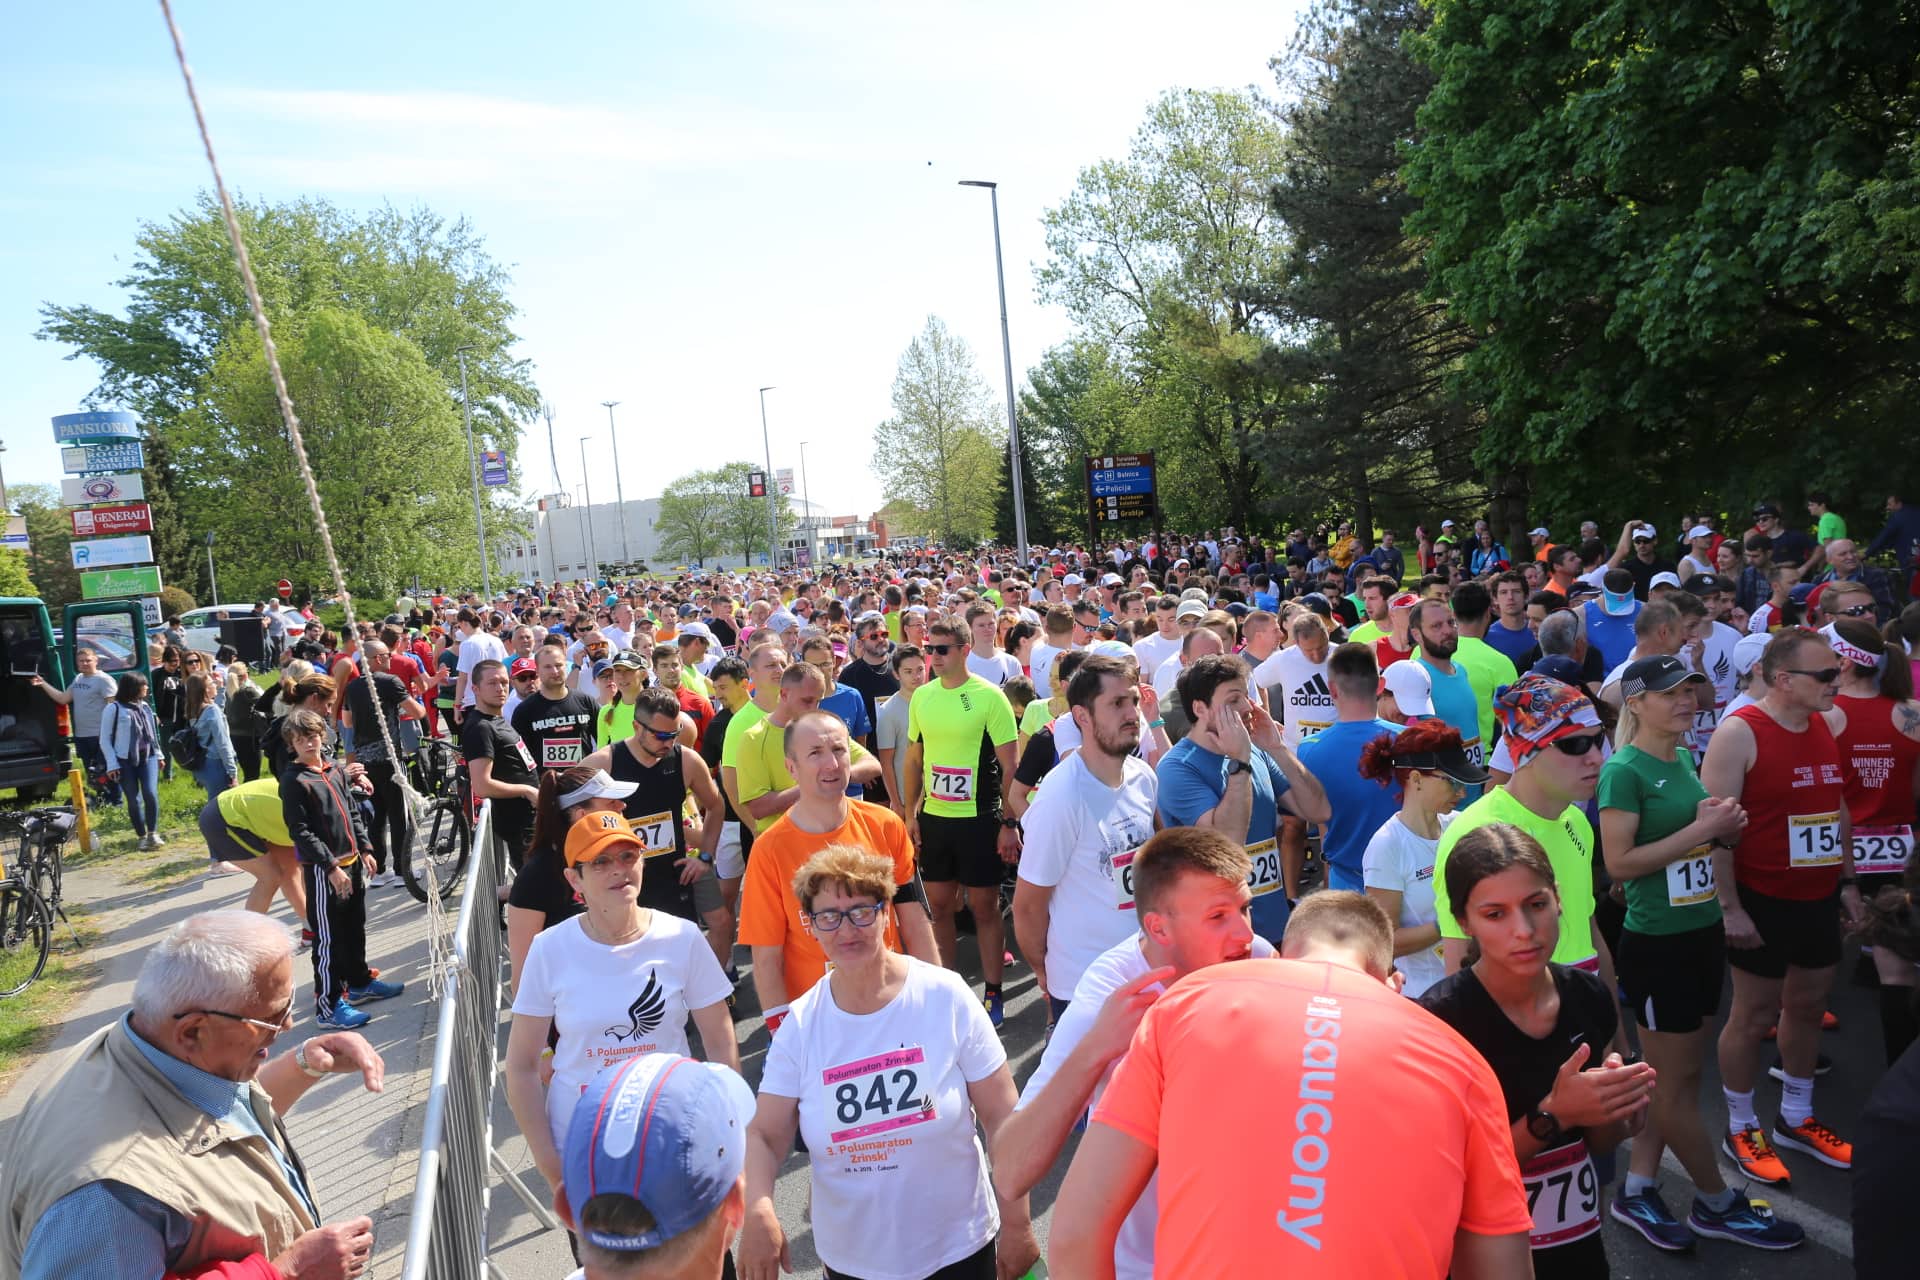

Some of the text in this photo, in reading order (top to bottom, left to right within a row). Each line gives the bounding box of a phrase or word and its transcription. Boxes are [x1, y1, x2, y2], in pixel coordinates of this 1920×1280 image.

[87, 442, 136, 452] SOBE
[88, 450, 138, 459] ROOMS
[88, 456, 138, 465] CAMERE
[88, 462, 140, 470] ZIMMER
[1105, 484, 1132, 493] Policija
[94, 510, 146, 522] GENERALI
[1120, 510, 1144, 518] Groblje
[144, 614, 159, 622] ON
[532, 715, 576, 731] MUSCLE
[577, 714, 591, 725] UP
[1695, 708, 1725, 728] 71
[547, 746, 578, 761] 887
[1851, 757, 1895, 768] WINNERS
[1858, 767, 1889, 778] NEVER
[931, 773, 966, 794] 712
[1863, 778, 1885, 788] QUIT
[1853, 836, 1908, 861] 529
[586, 1043, 656, 1058] 3. Polumaraton
[828, 1054, 914, 1081] Polumaraton Zrinski
[835, 1069, 923, 1124] 842
[1276, 1018, 1342, 1252] saucony
[827, 1137, 913, 1156] 3. Polumaraton
[851, 1151, 888, 1164] Zrinski
[1523, 1163, 1597, 1223] 779
[591, 1233, 649, 1247] HRVATSKA
